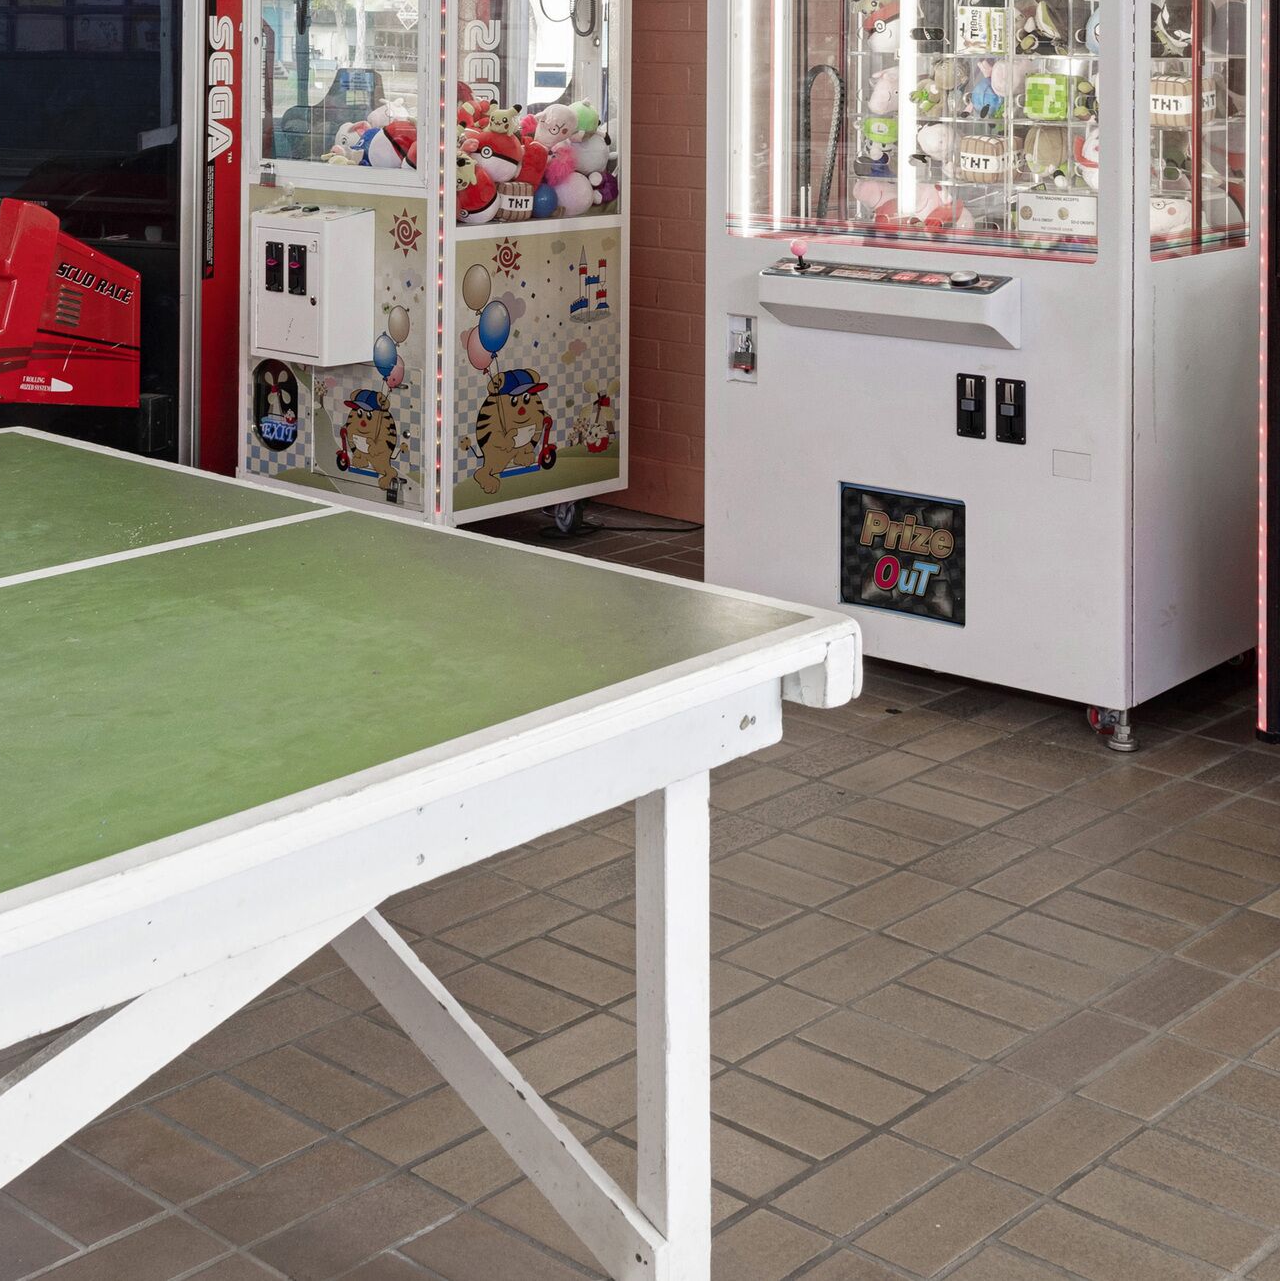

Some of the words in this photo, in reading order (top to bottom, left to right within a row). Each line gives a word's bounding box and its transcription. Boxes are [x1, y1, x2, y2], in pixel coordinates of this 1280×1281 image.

[207, 15, 234, 162] SEGA
[1151, 98, 1183, 112] TNT
[961, 156, 990, 170] TNT
[508, 198, 530, 210] TNT
[56, 263, 96, 289] SCUD
[95, 278, 134, 305] RACE
[260, 422, 297, 443] EXIT
[860, 509, 955, 559] Prize
